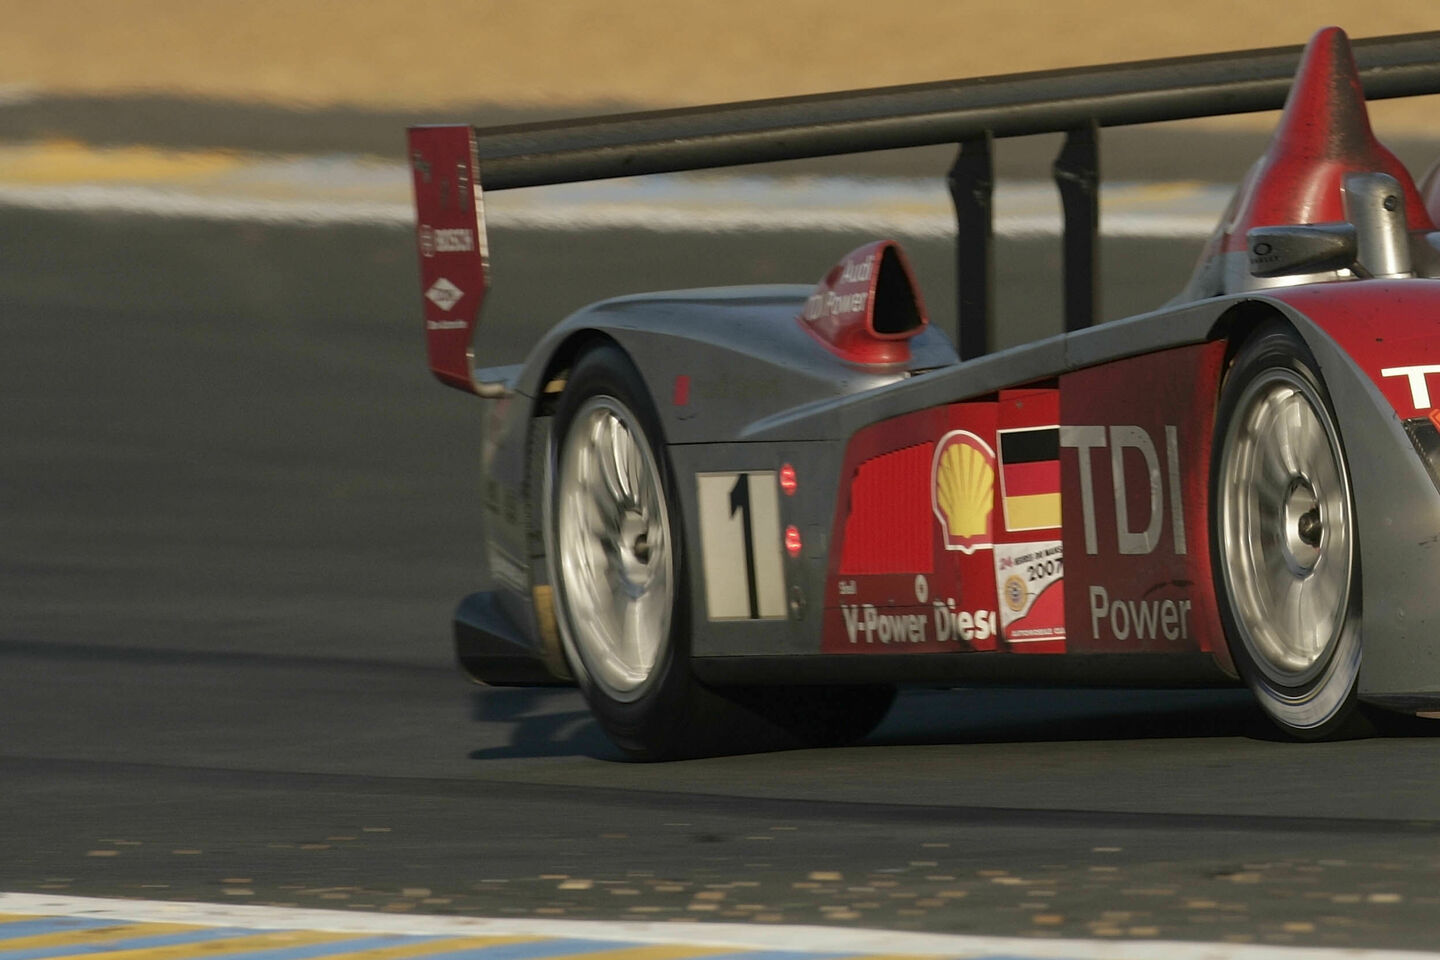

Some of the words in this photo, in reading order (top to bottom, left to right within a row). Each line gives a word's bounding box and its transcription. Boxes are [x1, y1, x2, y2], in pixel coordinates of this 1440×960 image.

[841, 254, 875, 285] Audi
[827, 290, 868, 315] Power
[1060, 424, 1187, 556] TDI
[729, 472, 761, 620] 1
[1027, 556, 1064, 583] 2007
[840, 603, 928, 644] V-Power
[1089, 585, 1192, 641] Power
